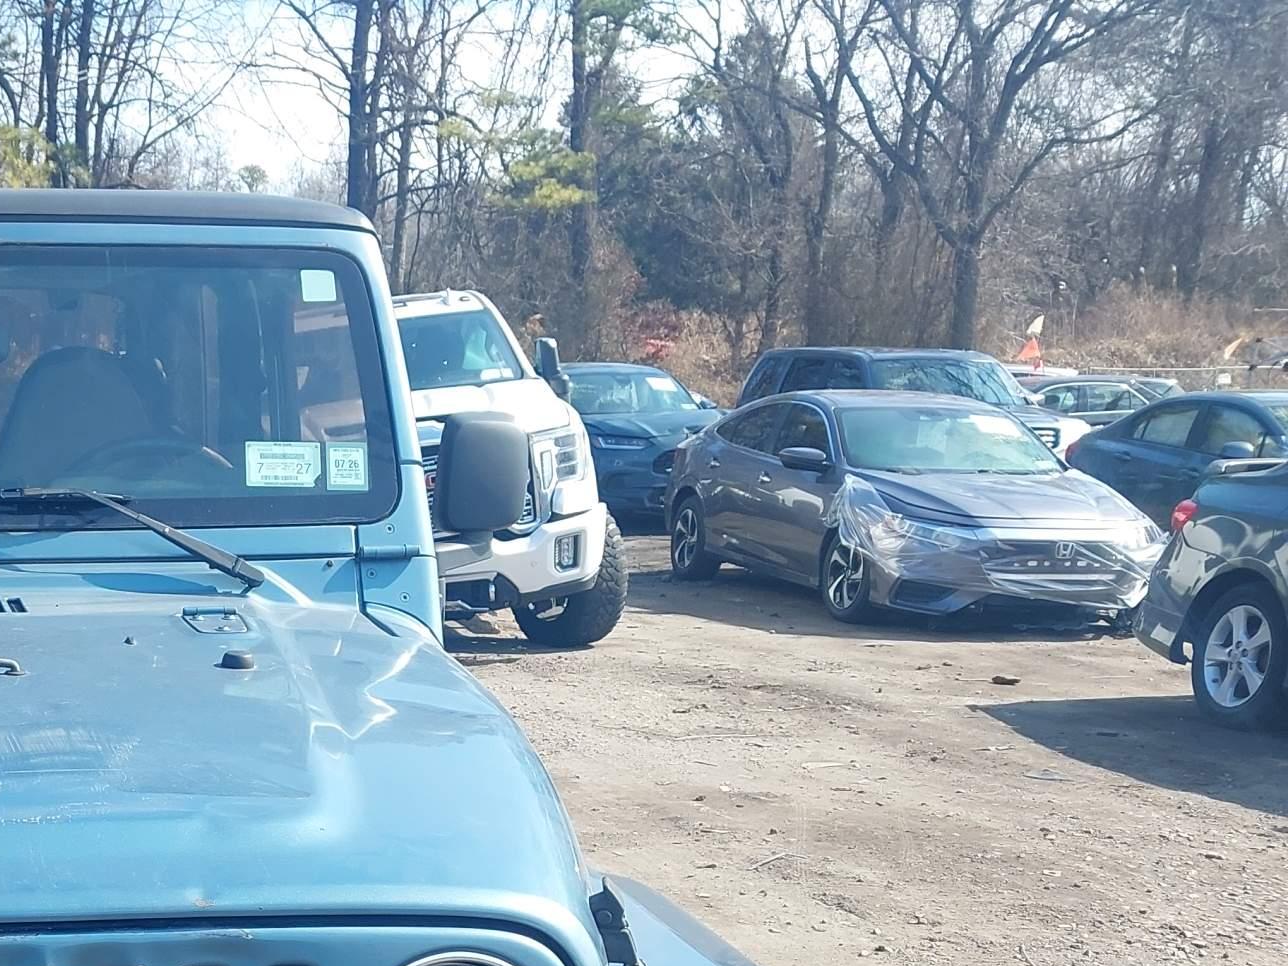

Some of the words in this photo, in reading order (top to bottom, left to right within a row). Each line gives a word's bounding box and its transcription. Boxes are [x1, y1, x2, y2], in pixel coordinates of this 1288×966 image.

[256, 462, 264, 473] 7
[296, 463, 312, 474] 27
[334, 459, 345, 469] 07
